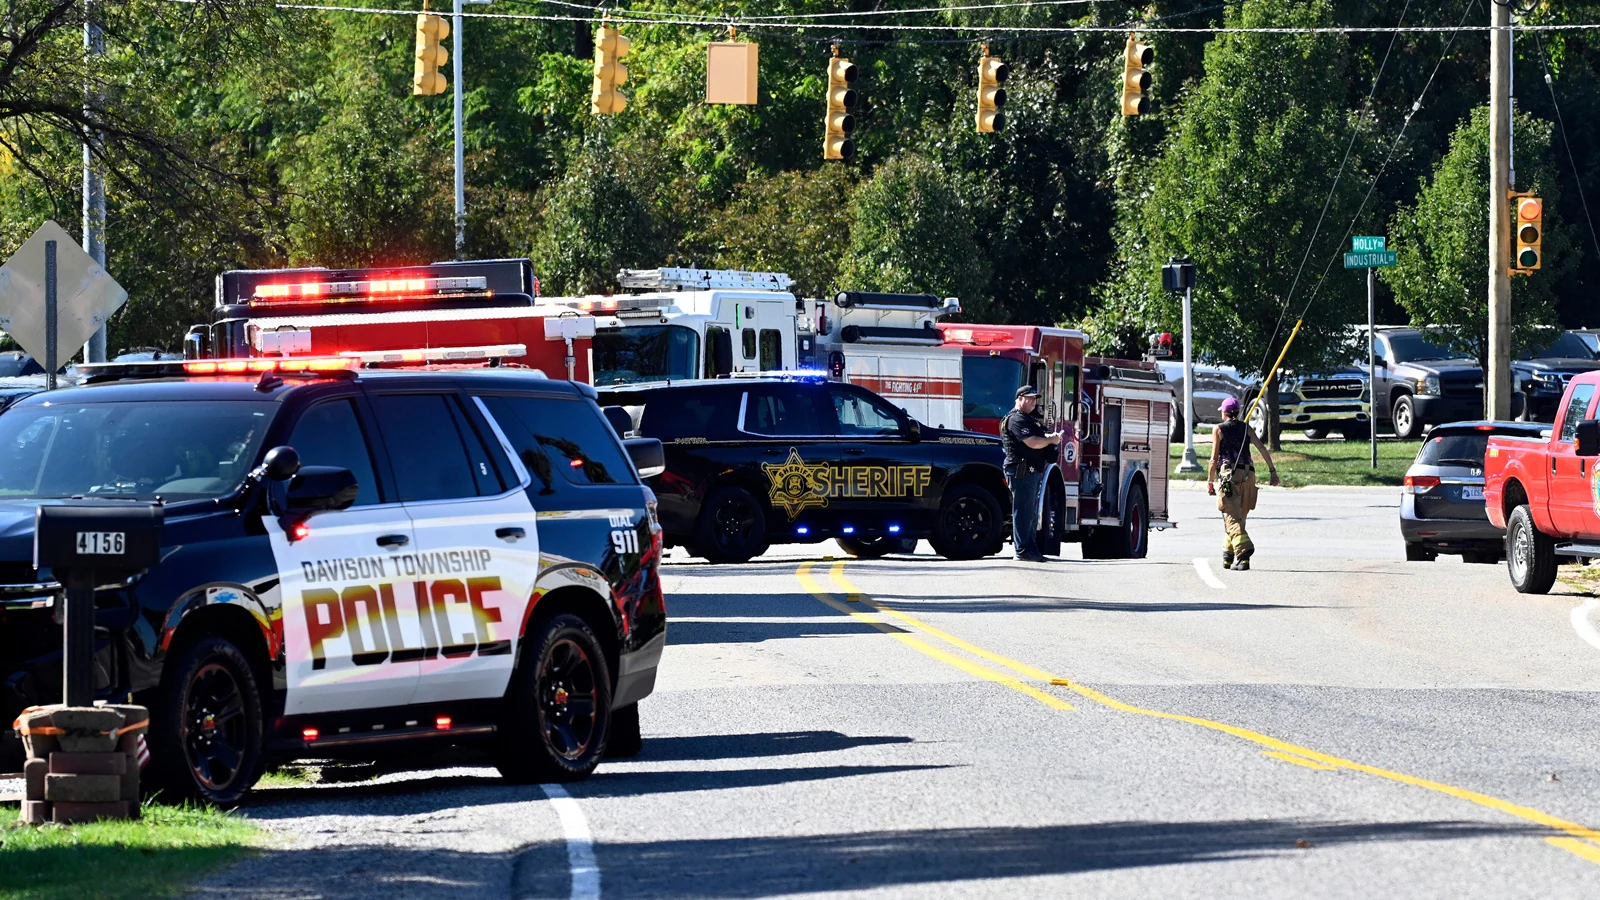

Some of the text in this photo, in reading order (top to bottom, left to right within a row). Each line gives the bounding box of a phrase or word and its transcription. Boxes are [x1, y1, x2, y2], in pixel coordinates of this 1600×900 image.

[1352, 238, 1377, 250] HOLLY
[1346, 253, 1388, 266] INDUSTRIAL
[891, 382, 912, 394] FIGHTING
[1067, 450, 1074, 461] 2
[778, 465, 812, 479] SHERIFF
[812, 465, 932, 498] SHERIFF
[608, 514, 635, 528] DIAL
[78, 533, 123, 553] 4156
[610, 529, 640, 554] 911
[301, 549, 492, 583] DAVISON TOWNSHIP
[301, 576, 512, 671] POLICE
